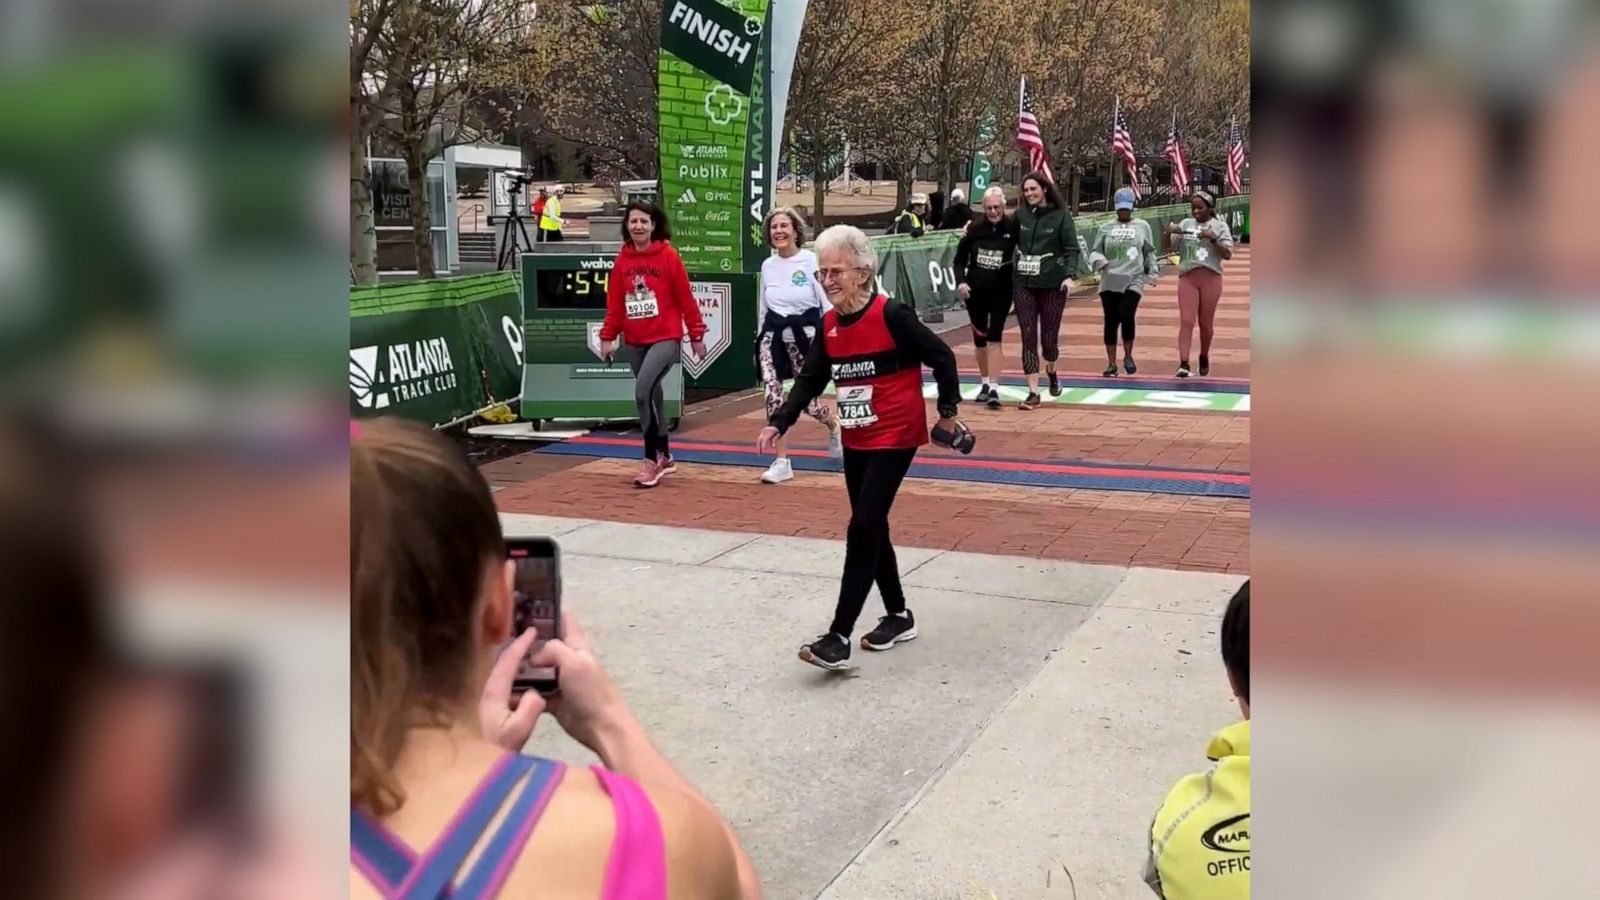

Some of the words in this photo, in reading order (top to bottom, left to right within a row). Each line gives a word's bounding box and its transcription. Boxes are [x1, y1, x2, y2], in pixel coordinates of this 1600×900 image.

[669, 1, 752, 64] FINISH
[696, 145, 728, 154] ATLANTA
[679, 165, 728, 178] Publix
[714, 192, 732, 201] PNC
[381, 207, 411, 219] CEN
[388, 337, 453, 384] ATLANTA
[841, 361, 876, 374] ATLANTA
[392, 379, 432, 403] TRACK
[435, 373, 457, 392] CLUB
[1218, 831, 1250, 844] MAR
